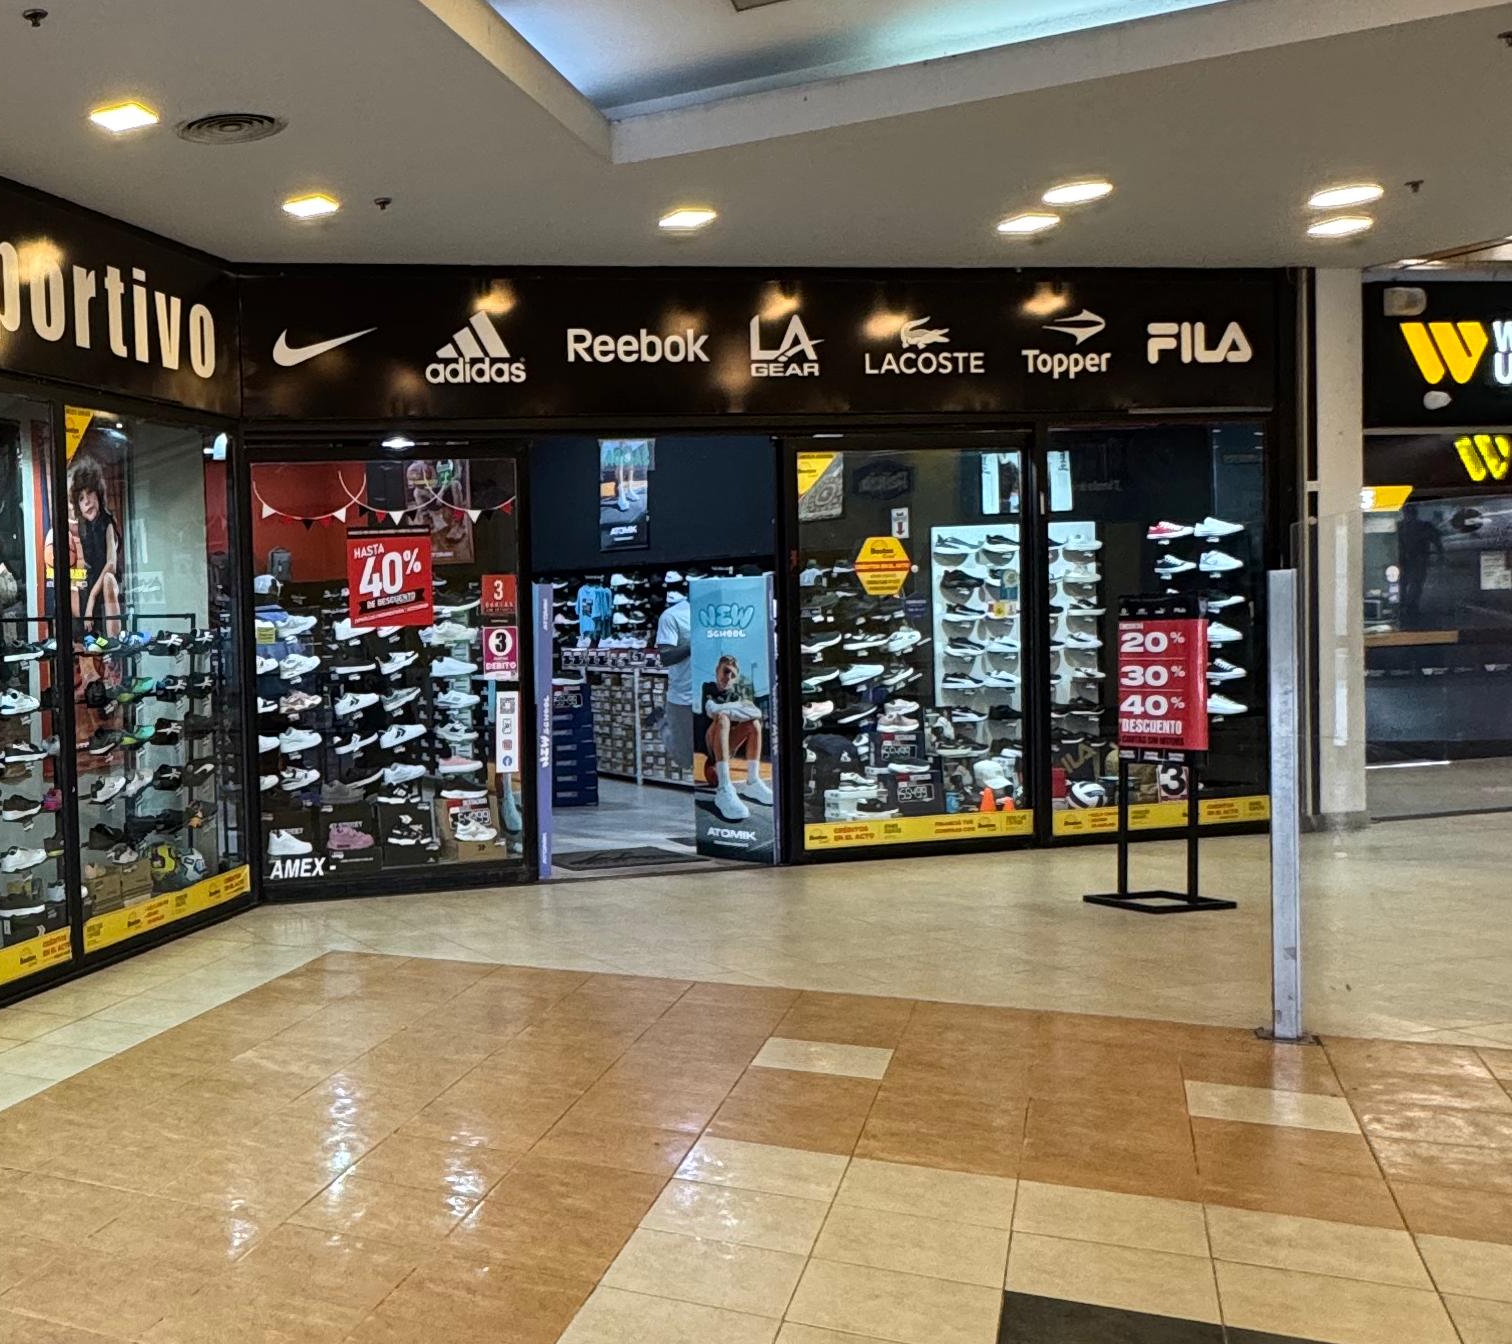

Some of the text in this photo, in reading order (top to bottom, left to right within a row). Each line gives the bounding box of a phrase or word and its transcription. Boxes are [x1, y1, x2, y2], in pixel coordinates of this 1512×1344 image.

[567, 328, 710, 363] Reebok
[1147, 322, 1253, 364] FILA
[425, 357, 526, 384] adidas
[751, 363, 819, 377] GEAR
[865, 351, 985, 375] LACOSTE
[1026, 349, 1111, 378] Topper
[354, 543, 384, 559] HASTA
[359, 548, 422, 597] 40%
[494, 580, 504, 600] 3
[699, 602, 755, 629] NEW
[495, 632, 507, 653] 3
[1120, 631, 1186, 653] 20%
[1120, 665, 1186, 686] 30%
[1120, 694, 1185, 716] 40%
[1121, 719, 1182, 735] DESCUENTO
[1159, 764, 1186, 796] 3
[707, 827, 757, 841] ATOMIK
[269, 857, 326, 880] AMEX
